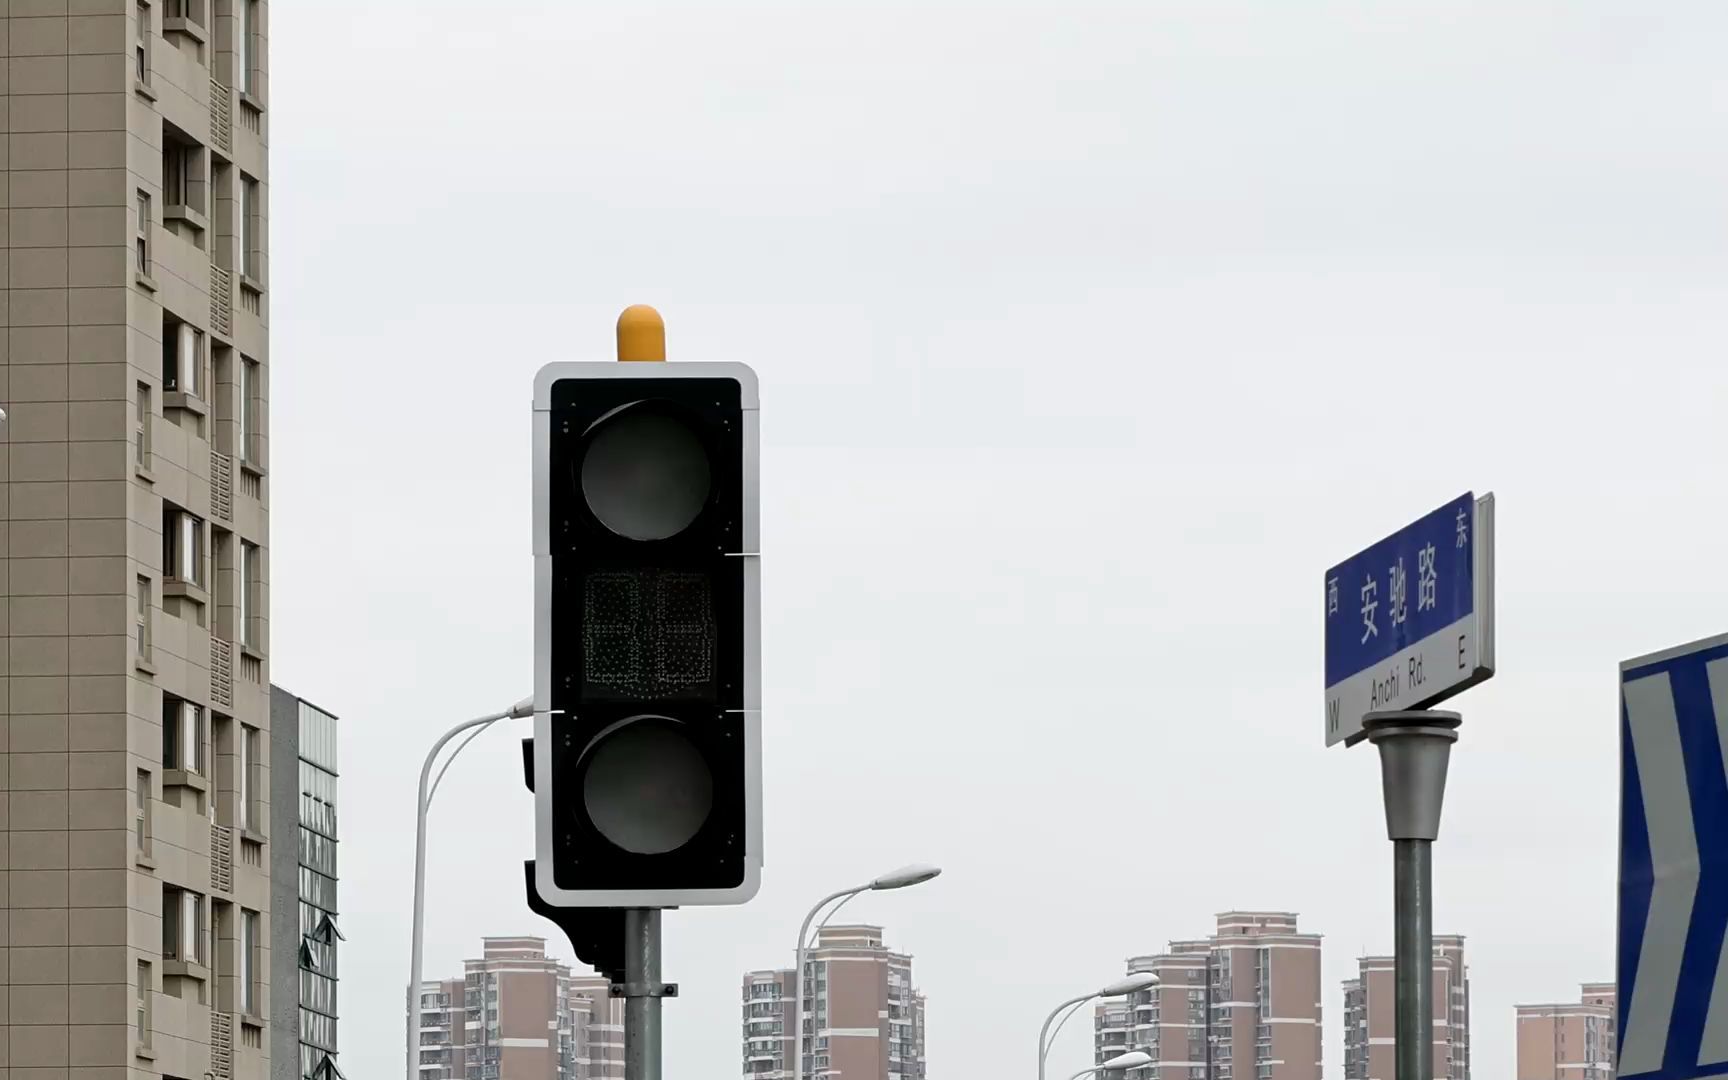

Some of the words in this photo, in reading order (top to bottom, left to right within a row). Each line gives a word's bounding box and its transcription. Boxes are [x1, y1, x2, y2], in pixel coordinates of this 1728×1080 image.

[1328, 577, 1338, 616] 西
[1361, 542, 1435, 644] 安驰路
[1456, 510, 1467, 548] 东
[1329, 698, 1341, 733] W
[1371, 667, 1399, 711] Anchi
[1409, 655, 1426, 691] Rd.
[1458, 636, 1466, 669] E
